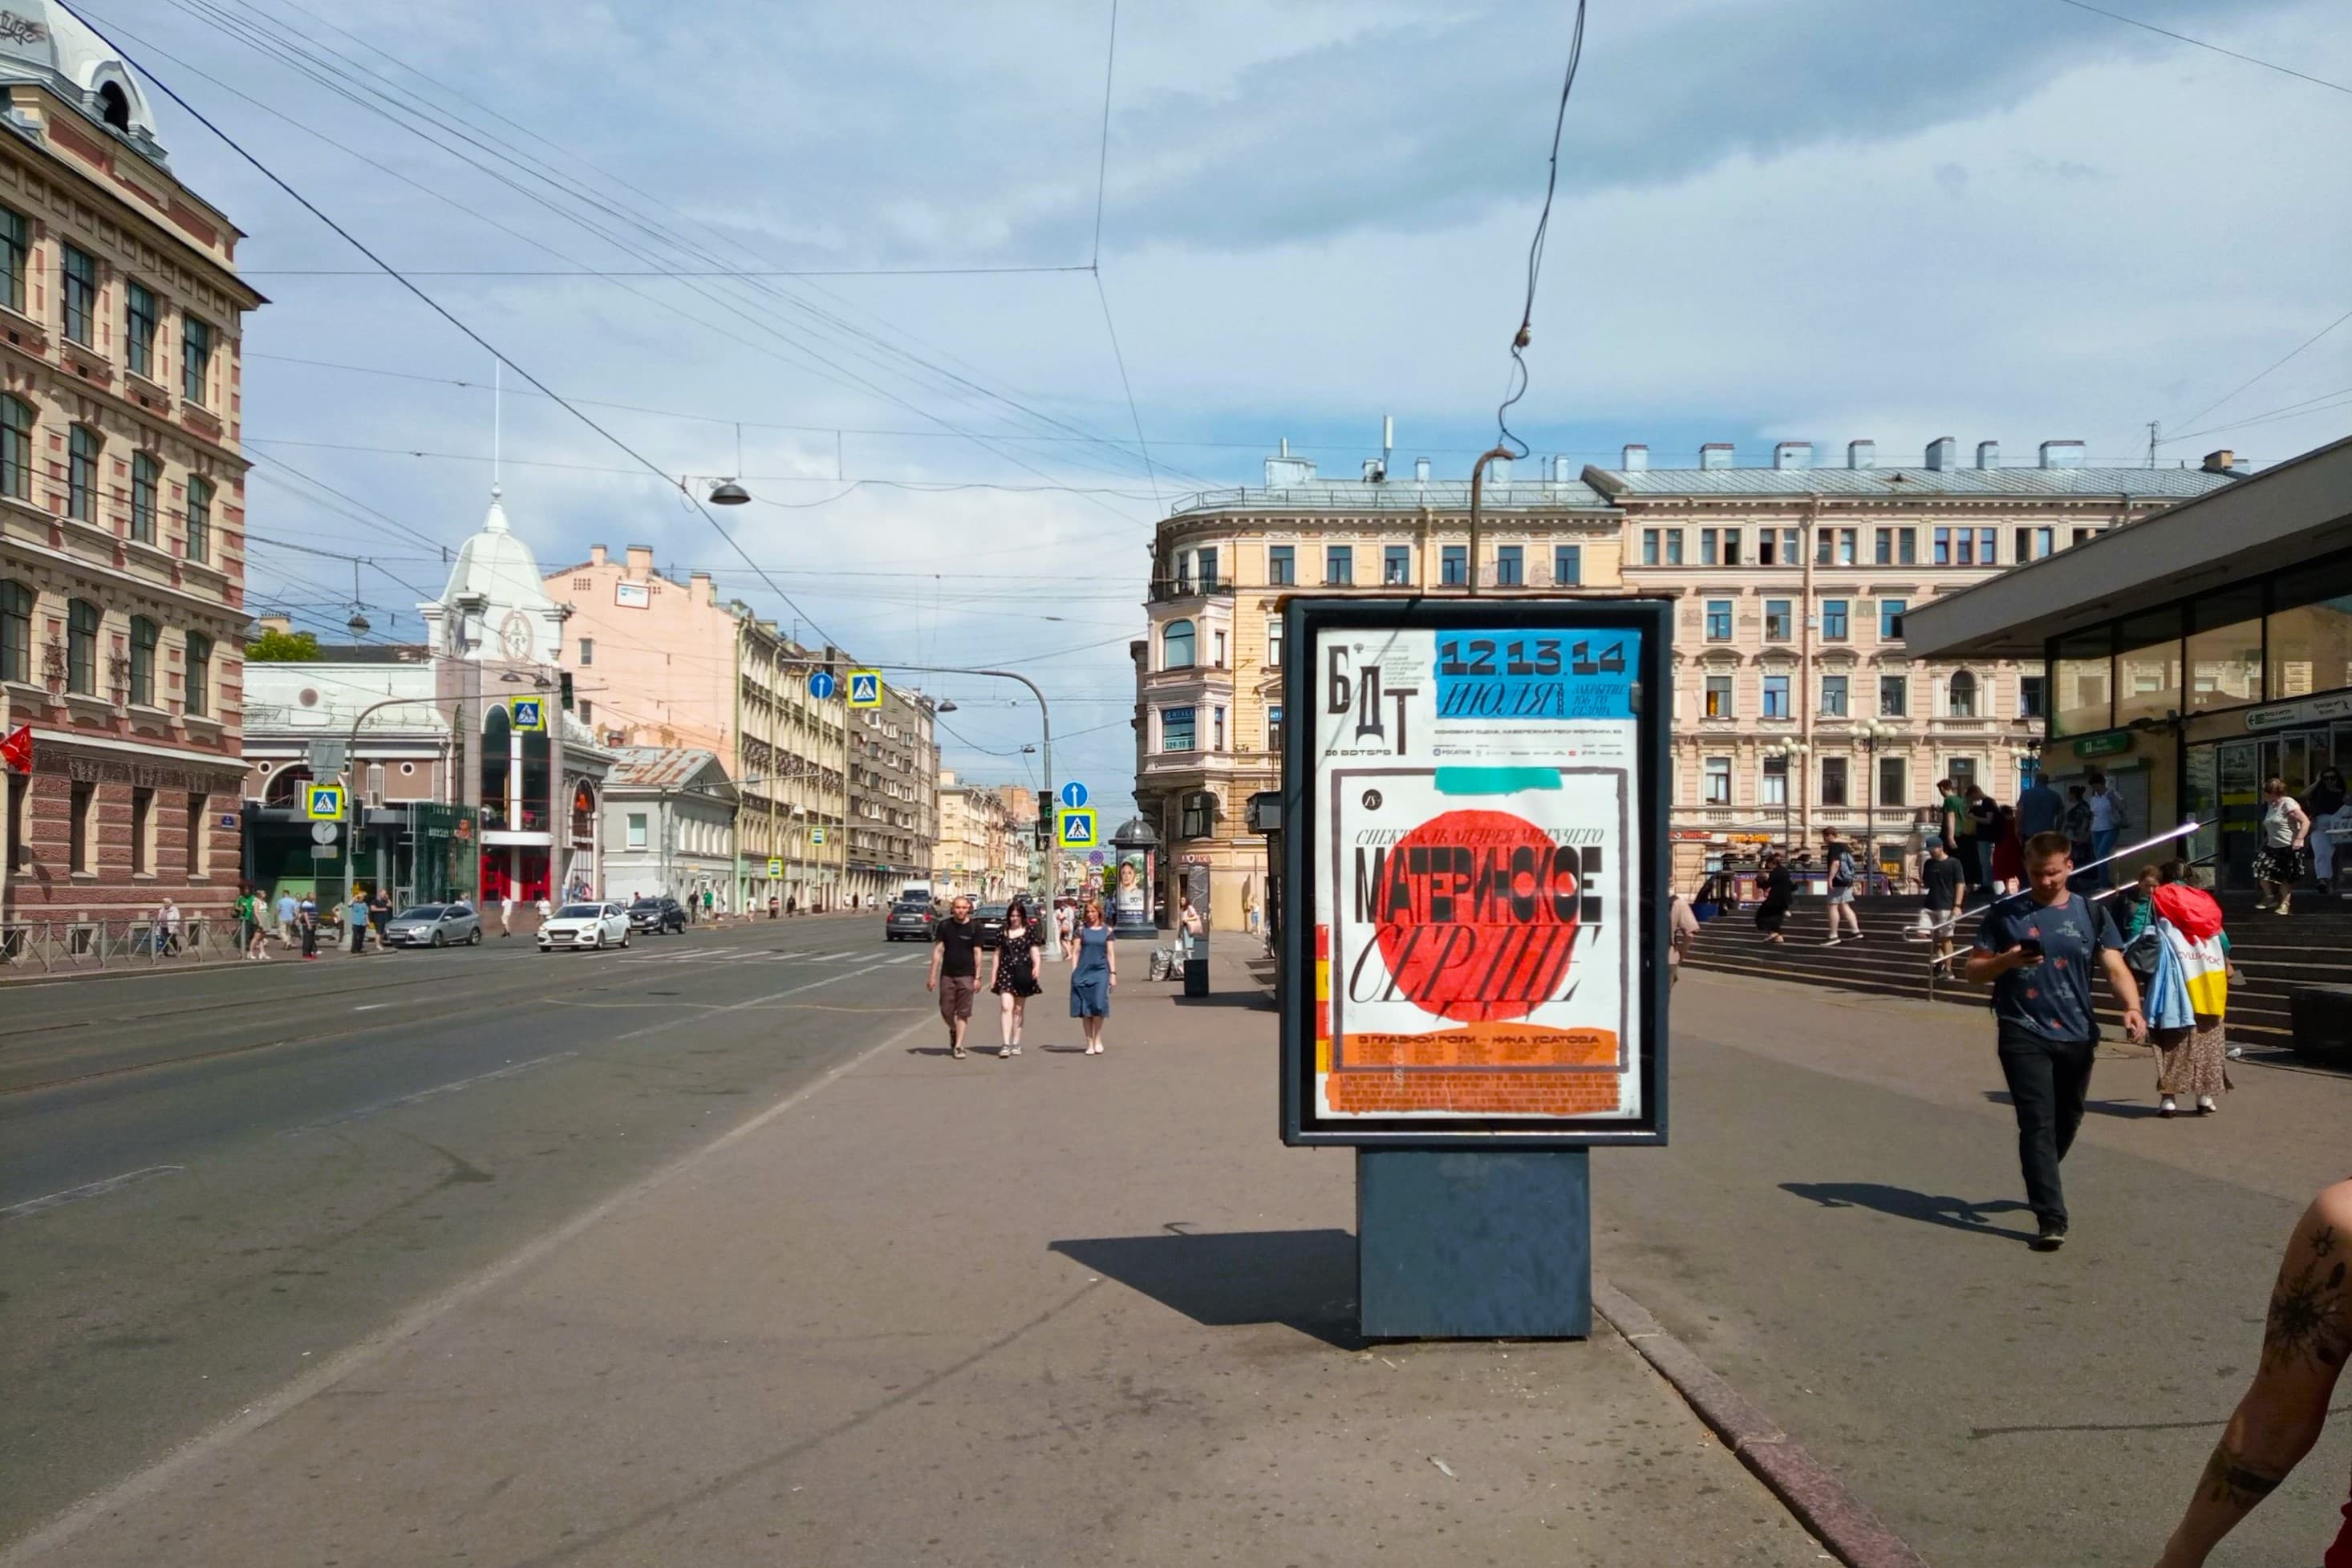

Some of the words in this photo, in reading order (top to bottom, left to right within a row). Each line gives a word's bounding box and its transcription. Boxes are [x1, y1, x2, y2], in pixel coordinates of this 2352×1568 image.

[1438, 682, 1556, 715] ИЮЛЯ
[1355, 845, 1603, 924] МАТЕРИНСКОЕ
[1348, 924, 1603, 1023] СЕРДЦЕ
[1358, 1035, 1369, 1044] В
[1372, 1034, 1435, 1044] ГЛАВНОЙ
[1438, 1035, 1477, 1044] РОЛИ
[1492, 1035, 1528, 1044] НИНА
[1531, 1035, 1600, 1045] УСАТОВА
